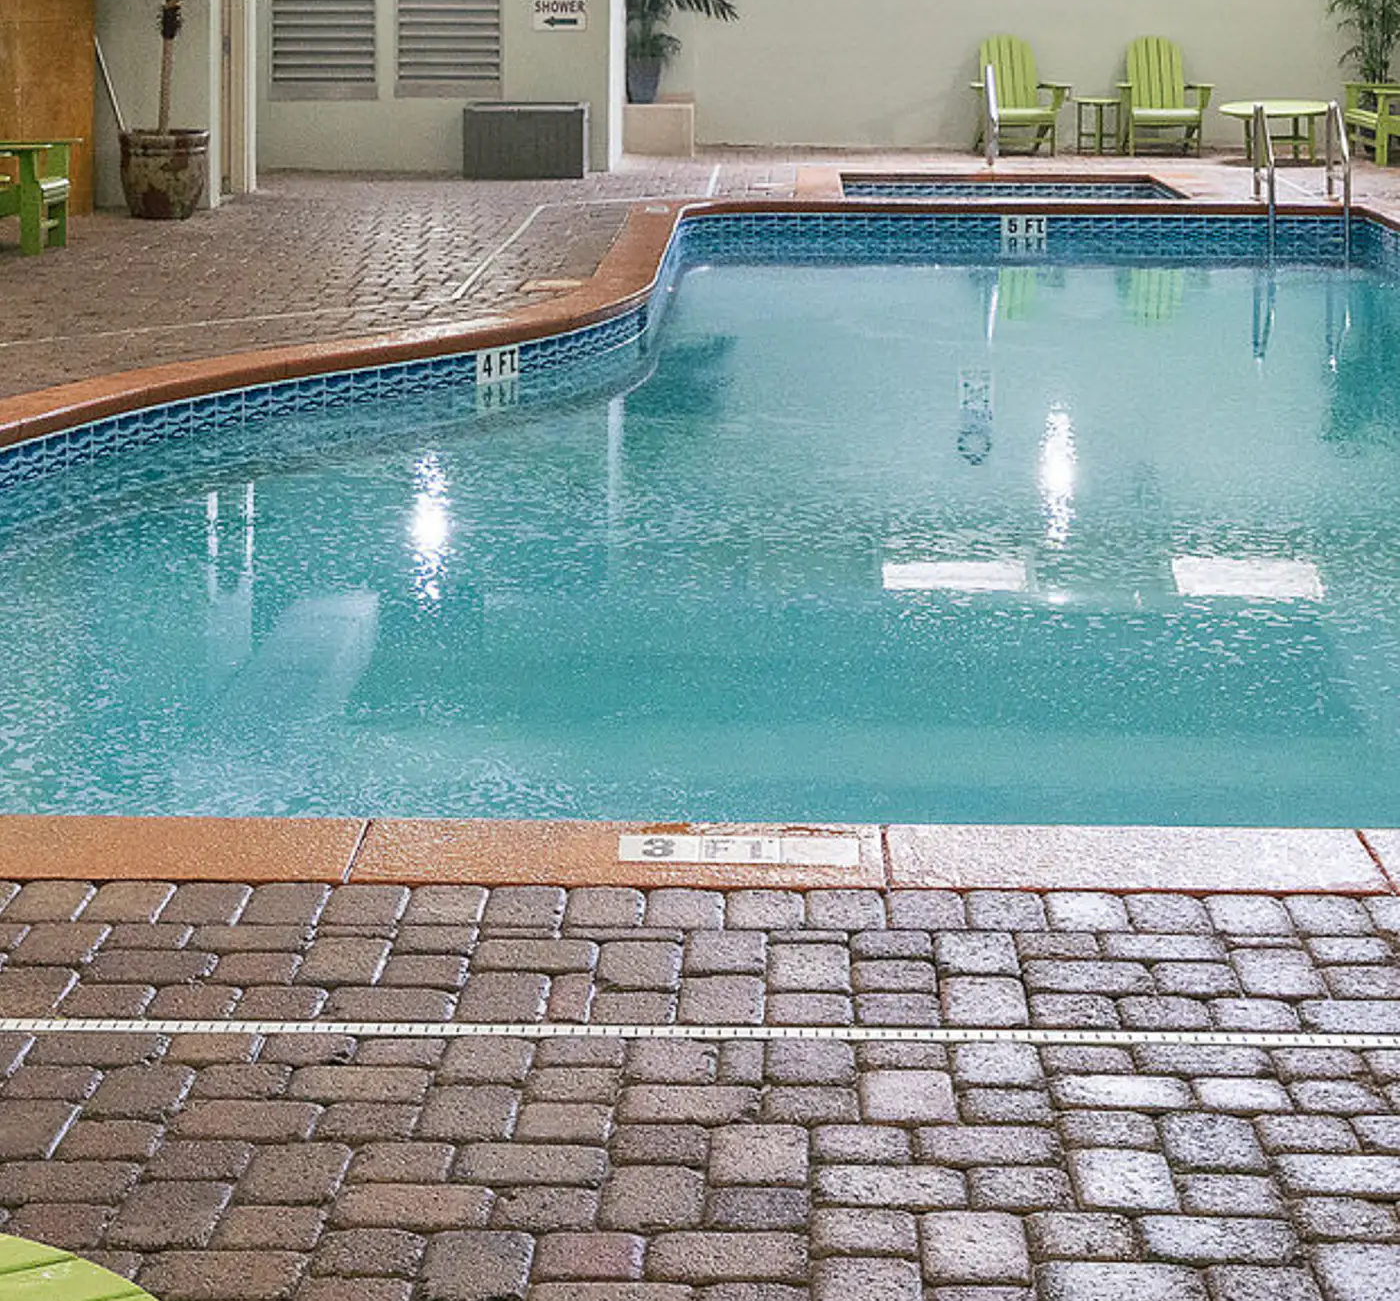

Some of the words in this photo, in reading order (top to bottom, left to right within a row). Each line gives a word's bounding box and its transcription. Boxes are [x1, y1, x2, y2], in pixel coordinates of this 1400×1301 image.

[534, 0, 585, 14] SHOWER
[1008, 217, 1018, 234] 5
[482, 354, 492, 378] 4
